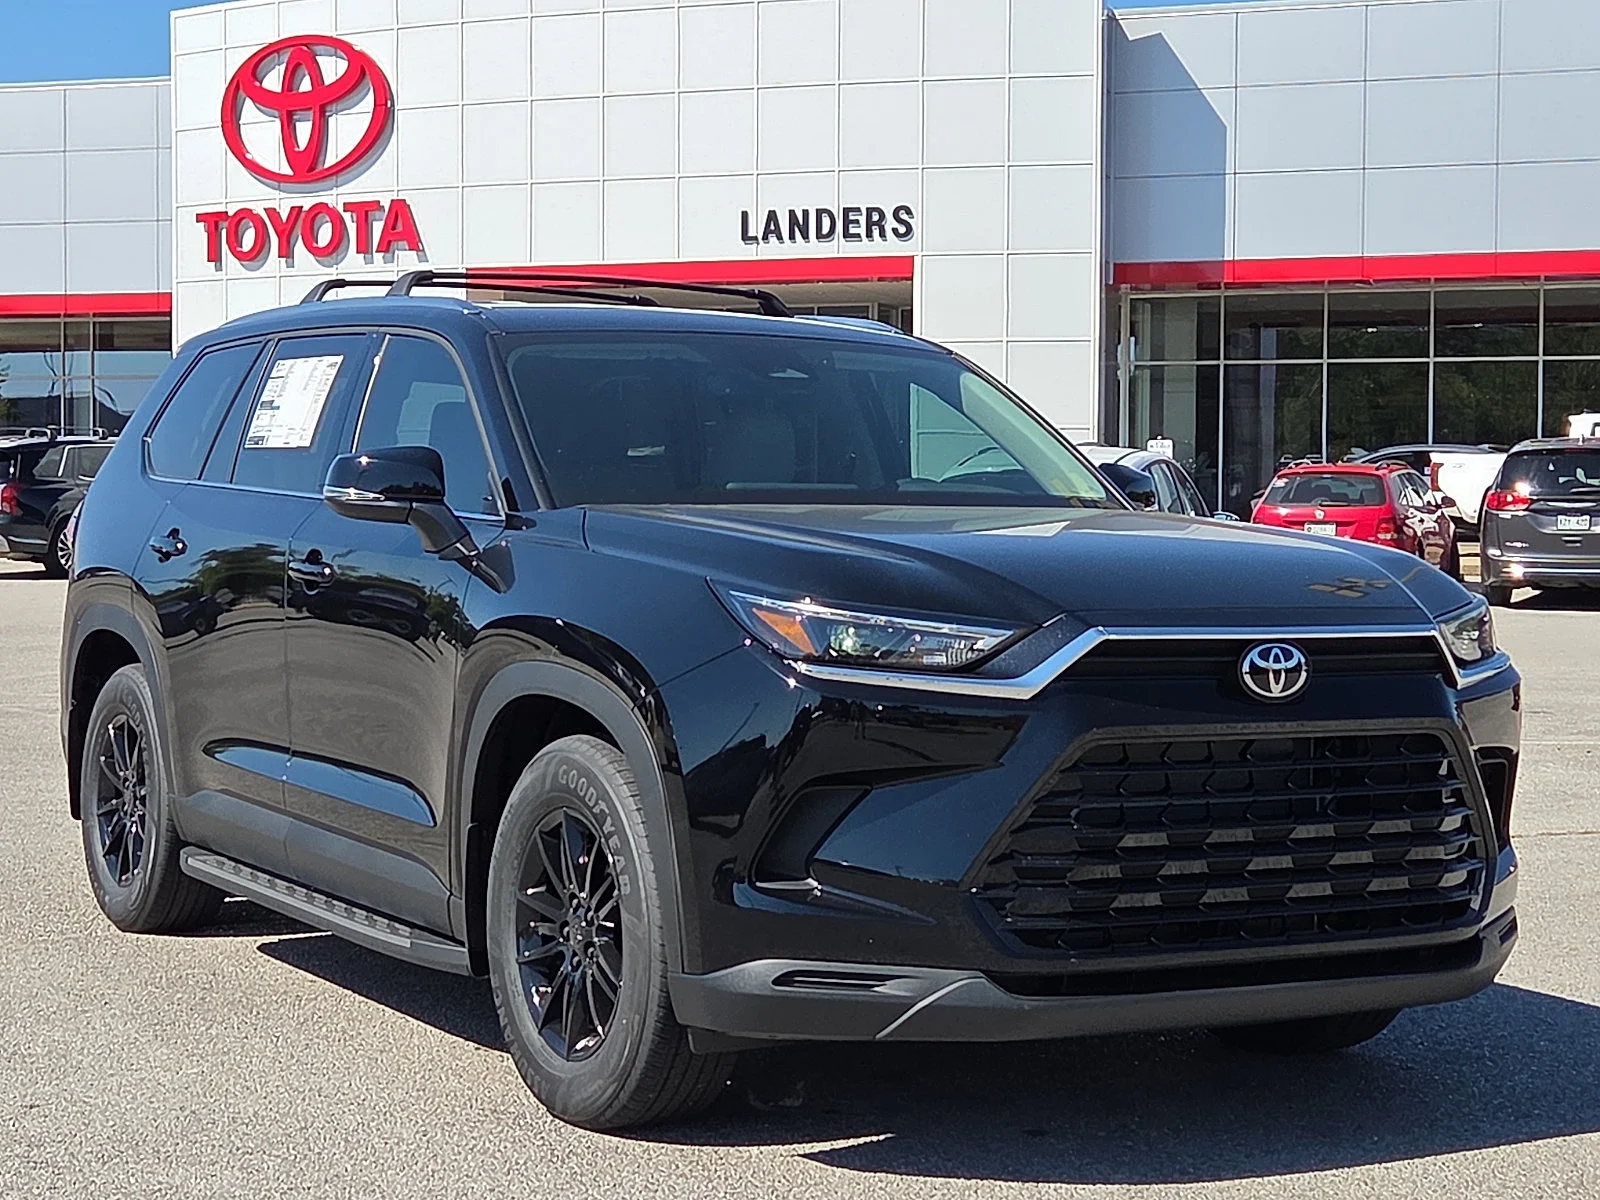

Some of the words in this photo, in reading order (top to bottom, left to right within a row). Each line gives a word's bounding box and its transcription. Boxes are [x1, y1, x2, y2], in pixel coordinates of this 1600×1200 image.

[196, 199, 424, 263] TOYOTA
[741, 205, 915, 243] LANDERS
[558, 764, 631, 895] GOODYEAR
